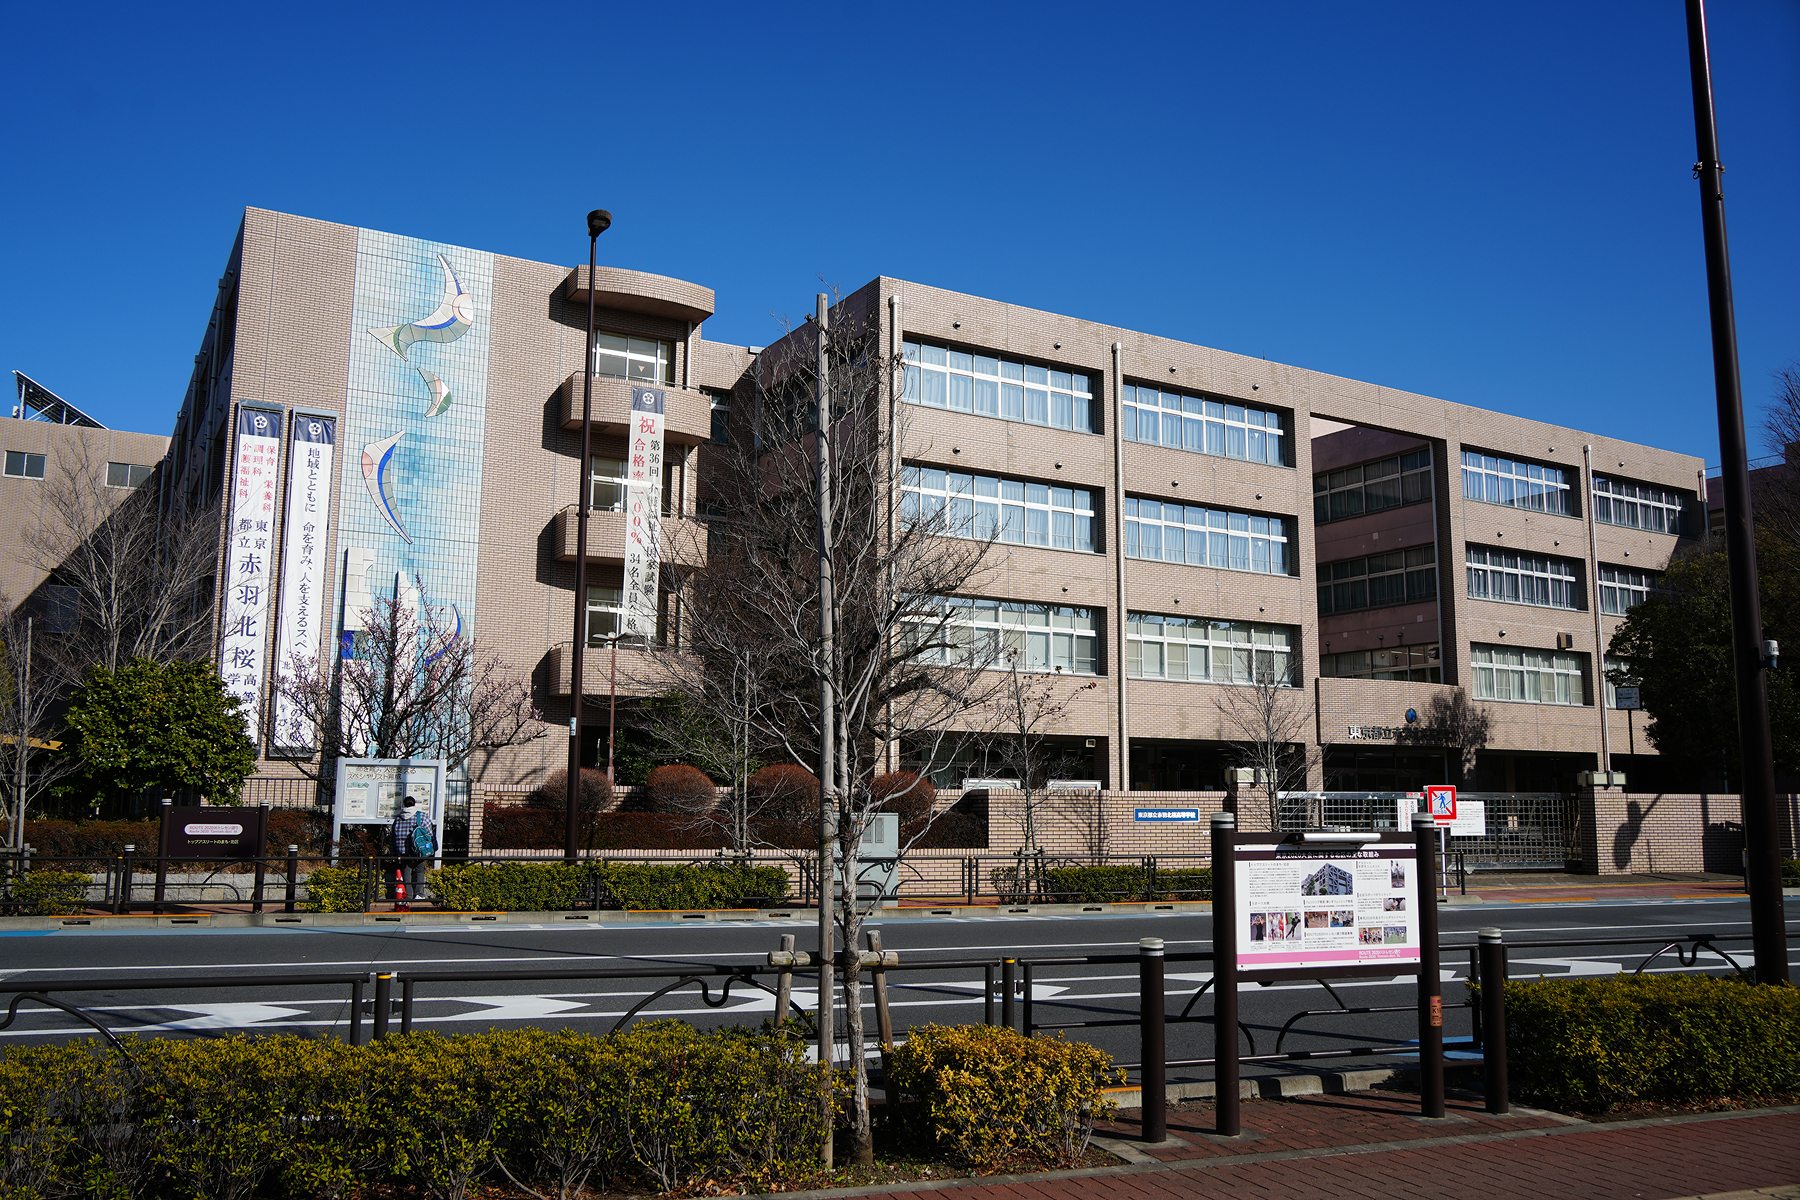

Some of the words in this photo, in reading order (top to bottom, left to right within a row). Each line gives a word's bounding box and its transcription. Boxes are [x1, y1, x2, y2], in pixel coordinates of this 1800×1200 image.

[639, 416, 656, 435] 祝
[238, 442, 252, 499] 介護福祉科
[252, 444, 264, 477] 調理科
[649, 440, 661, 477] 第36回
[262, 445, 276, 513] 保育・栄養科
[304, 447, 320, 513] 地域とともに
[1275, 851, 1380, 859] 東京2020大会に関する北区の主な取組み
